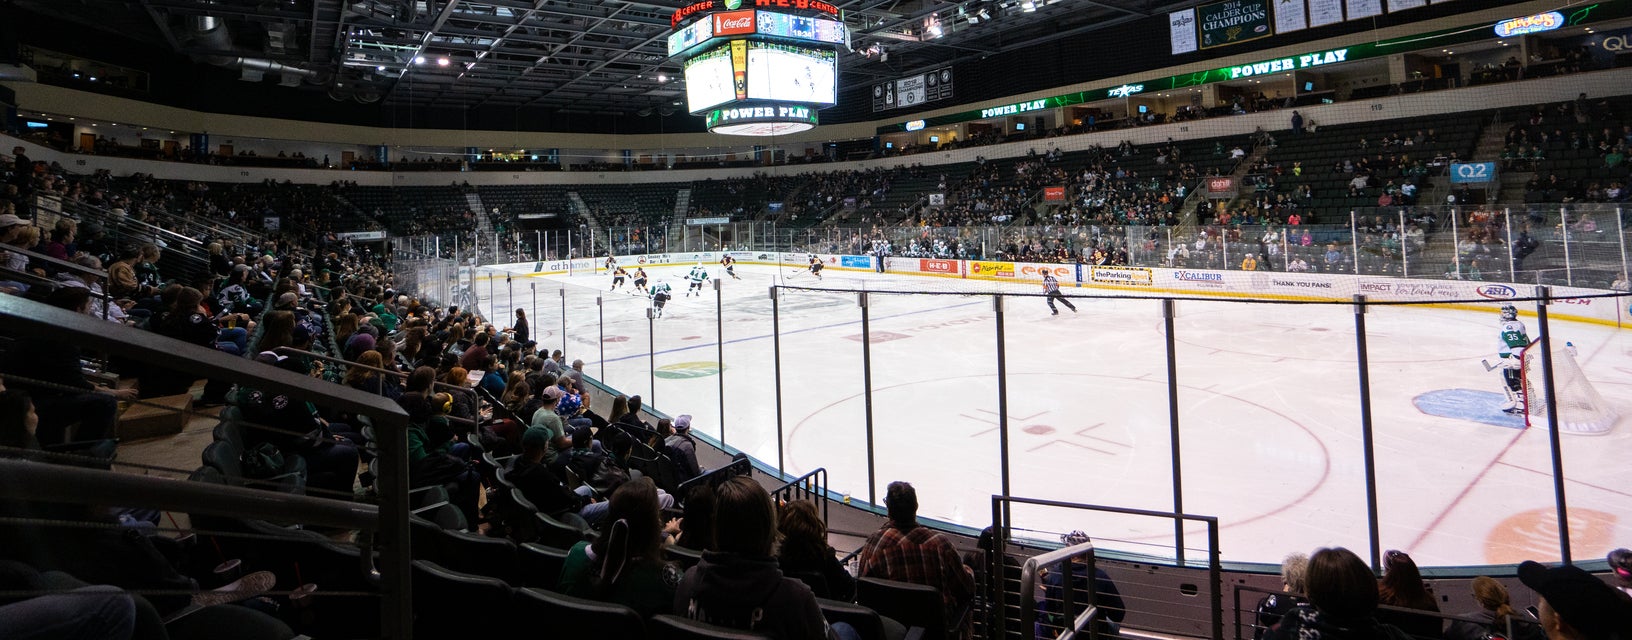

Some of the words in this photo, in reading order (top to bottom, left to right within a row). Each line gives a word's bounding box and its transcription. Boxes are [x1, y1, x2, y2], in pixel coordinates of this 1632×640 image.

[682, 1, 713, 16] CENTER
[810, 1, 838, 15] CENTER
[1205, 8, 1241, 22] CALDER
[1242, 4, 1261, 14] CUP
[1223, 1, 1241, 11] 2014
[1203, 9, 1266, 31] CHAMPIONS
[1231, 58, 1295, 79] POWER
[1300, 48, 1348, 67] PLAY
[722, 107, 775, 121] POWER
[779, 106, 809, 119] PLAY
[982, 104, 1018, 118] POWER
[1019, 99, 1046, 114] PLAY
[550, 261, 561, 271] at
[1174, 271, 1222, 281] EXCALIBUR
[1360, 283, 1391, 291] IMPACT
[1507, 333, 1519, 341] 35
